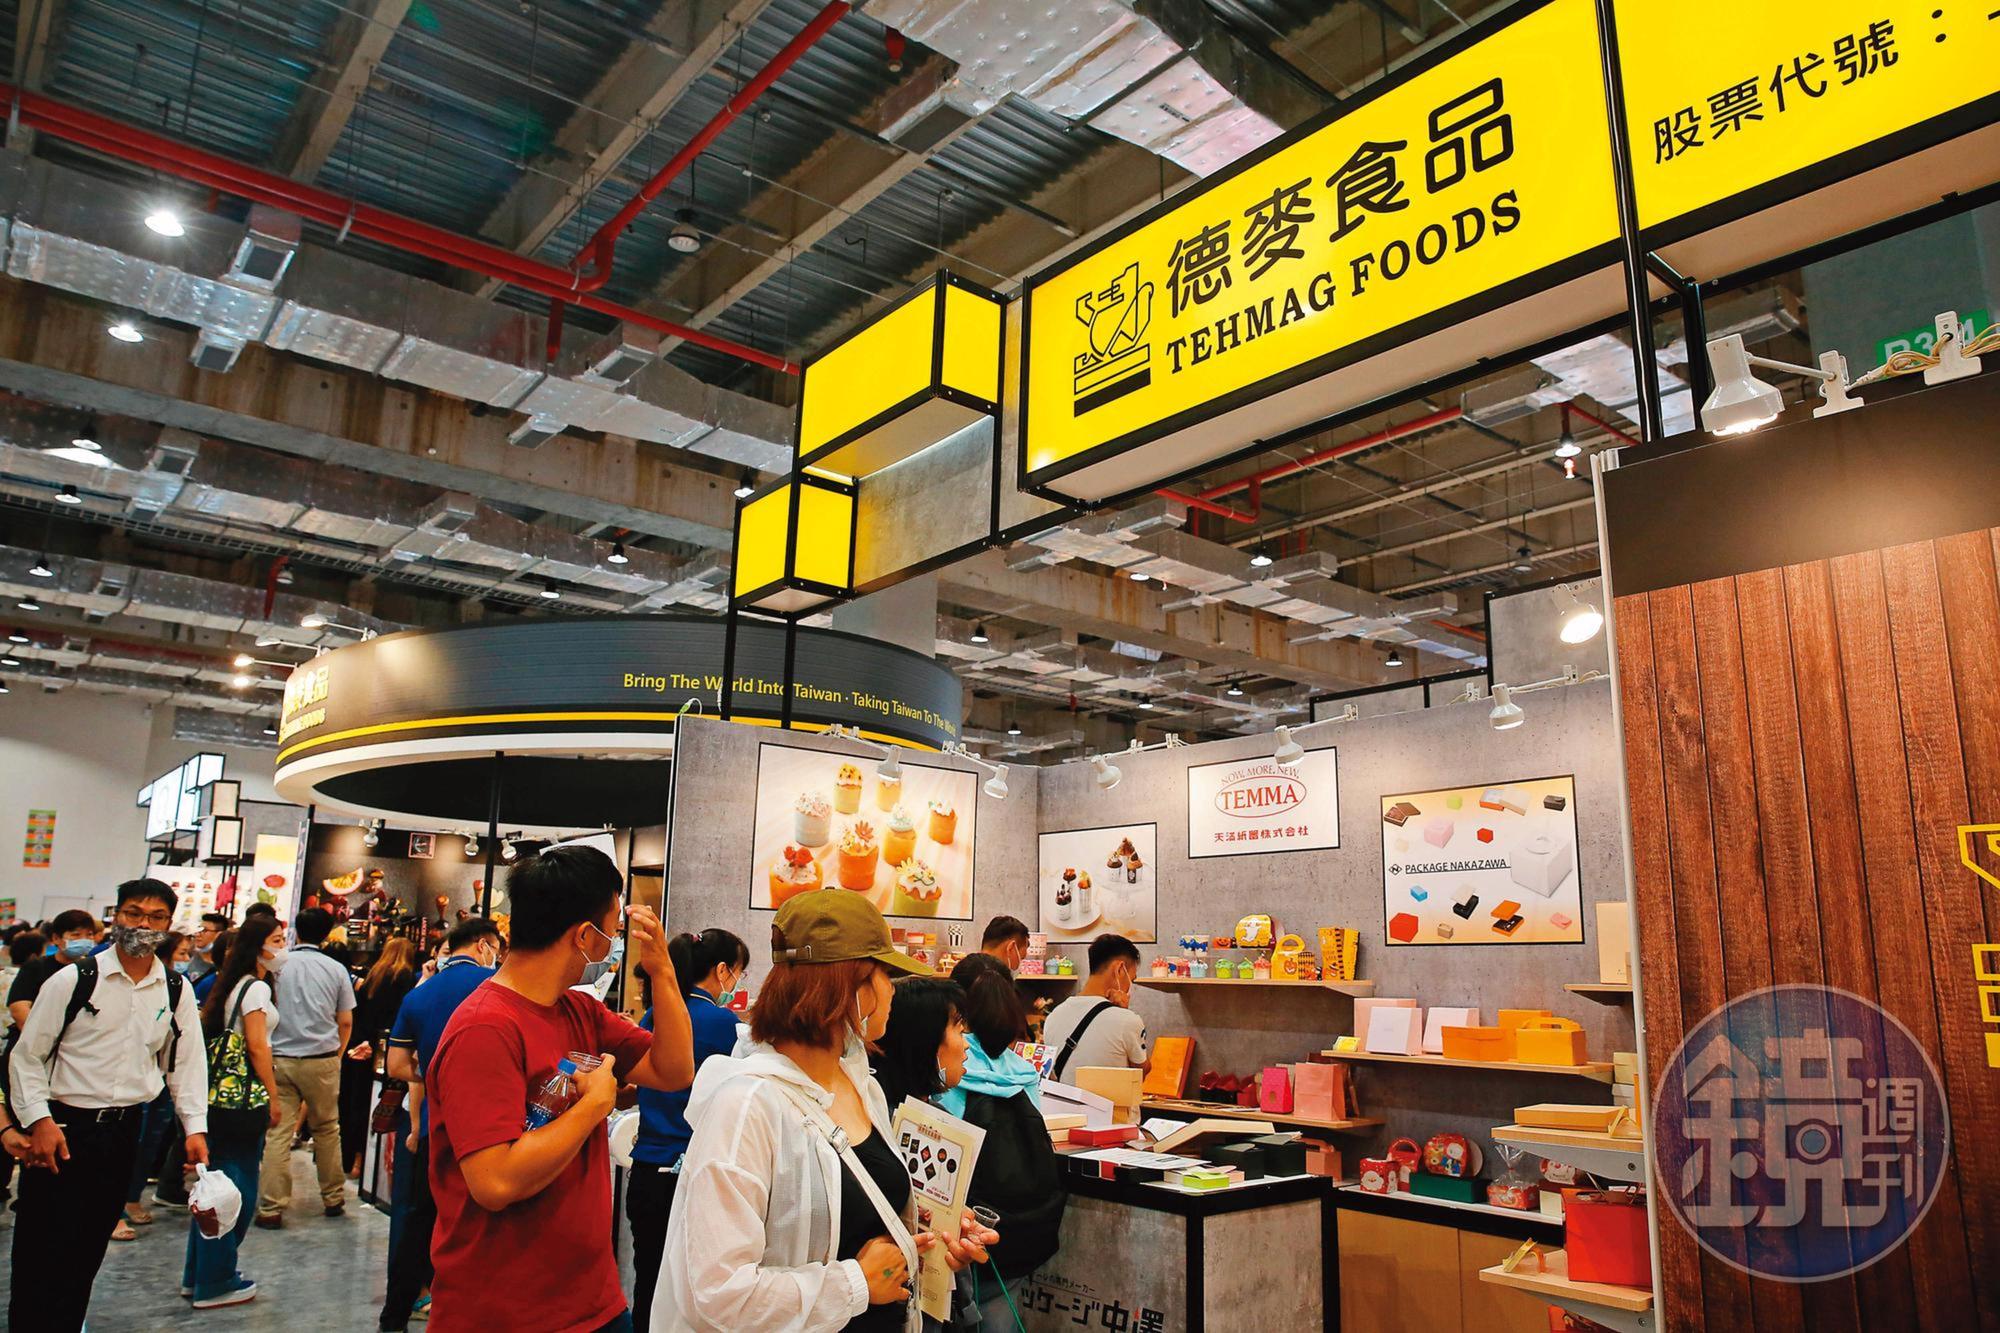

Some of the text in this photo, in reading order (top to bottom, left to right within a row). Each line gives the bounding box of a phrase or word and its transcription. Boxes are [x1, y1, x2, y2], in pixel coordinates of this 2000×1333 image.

[1654, 9, 2000, 164] 股票代號：
[1166, 77, 1516, 318] 德麥食品
[1166, 190, 1521, 374] TEHMAG FOODS
[624, 673, 666, 692] Bring
[670, 674, 700, 689] The
[705, 675, 754, 693] Wrld
[793, 683, 842, 703] Taiwan
[852, 691, 890, 715] Taking
[892, 700, 922, 721] Taiwan
[923, 709, 933, 724] To
[1221, 784, 1299, 810] TEMMA
[1405, 859, 1507, 874] PACKAGE NAKAZAWA
